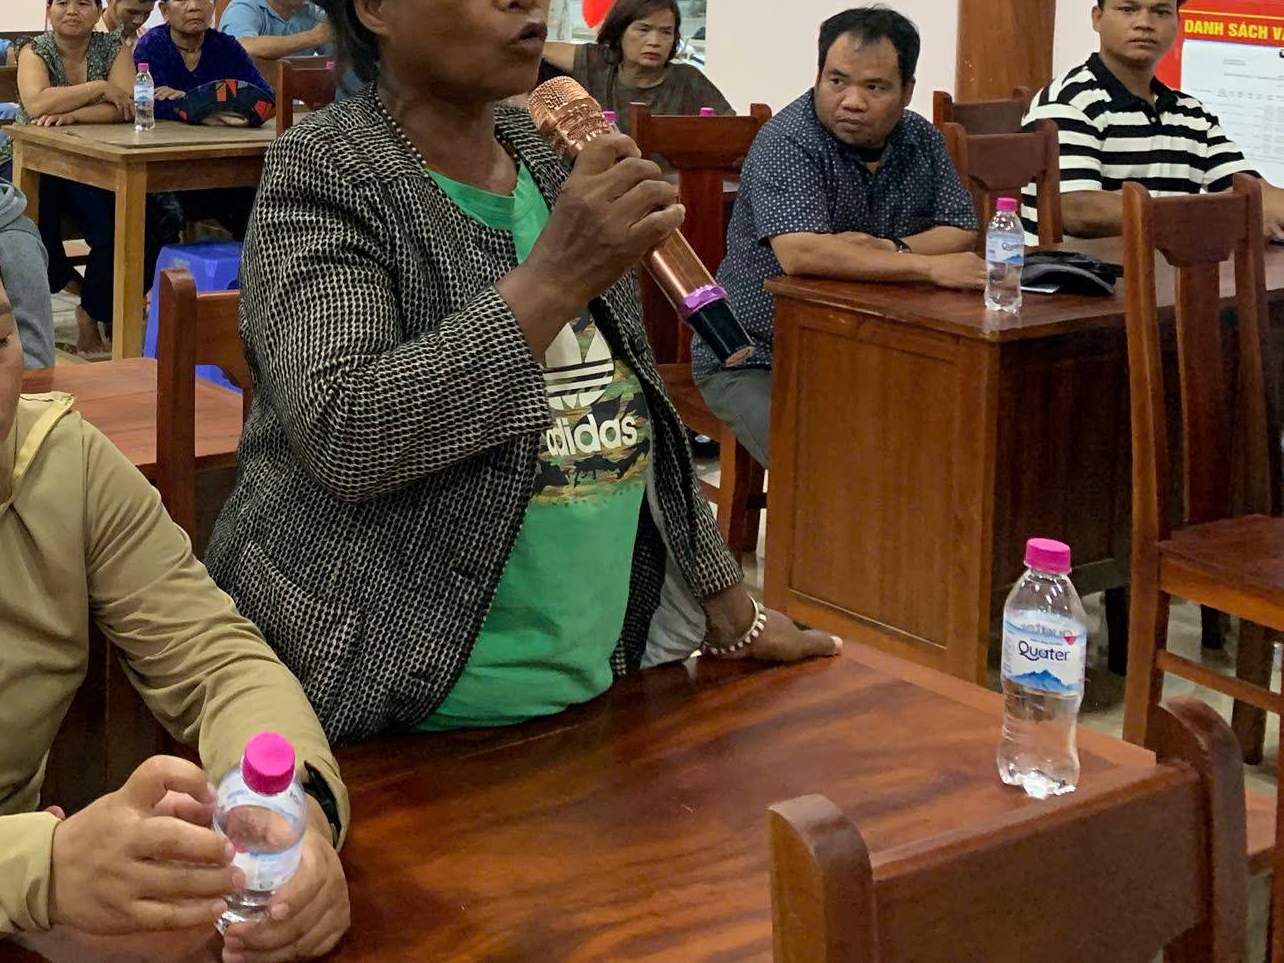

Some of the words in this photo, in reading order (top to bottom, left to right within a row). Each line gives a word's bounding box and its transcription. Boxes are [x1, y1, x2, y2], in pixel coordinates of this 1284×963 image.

[1184, 20, 1223, 35] DANH
[1227, 22, 1268, 39] SÁCH
[1018, 640, 1070, 662] Quater
